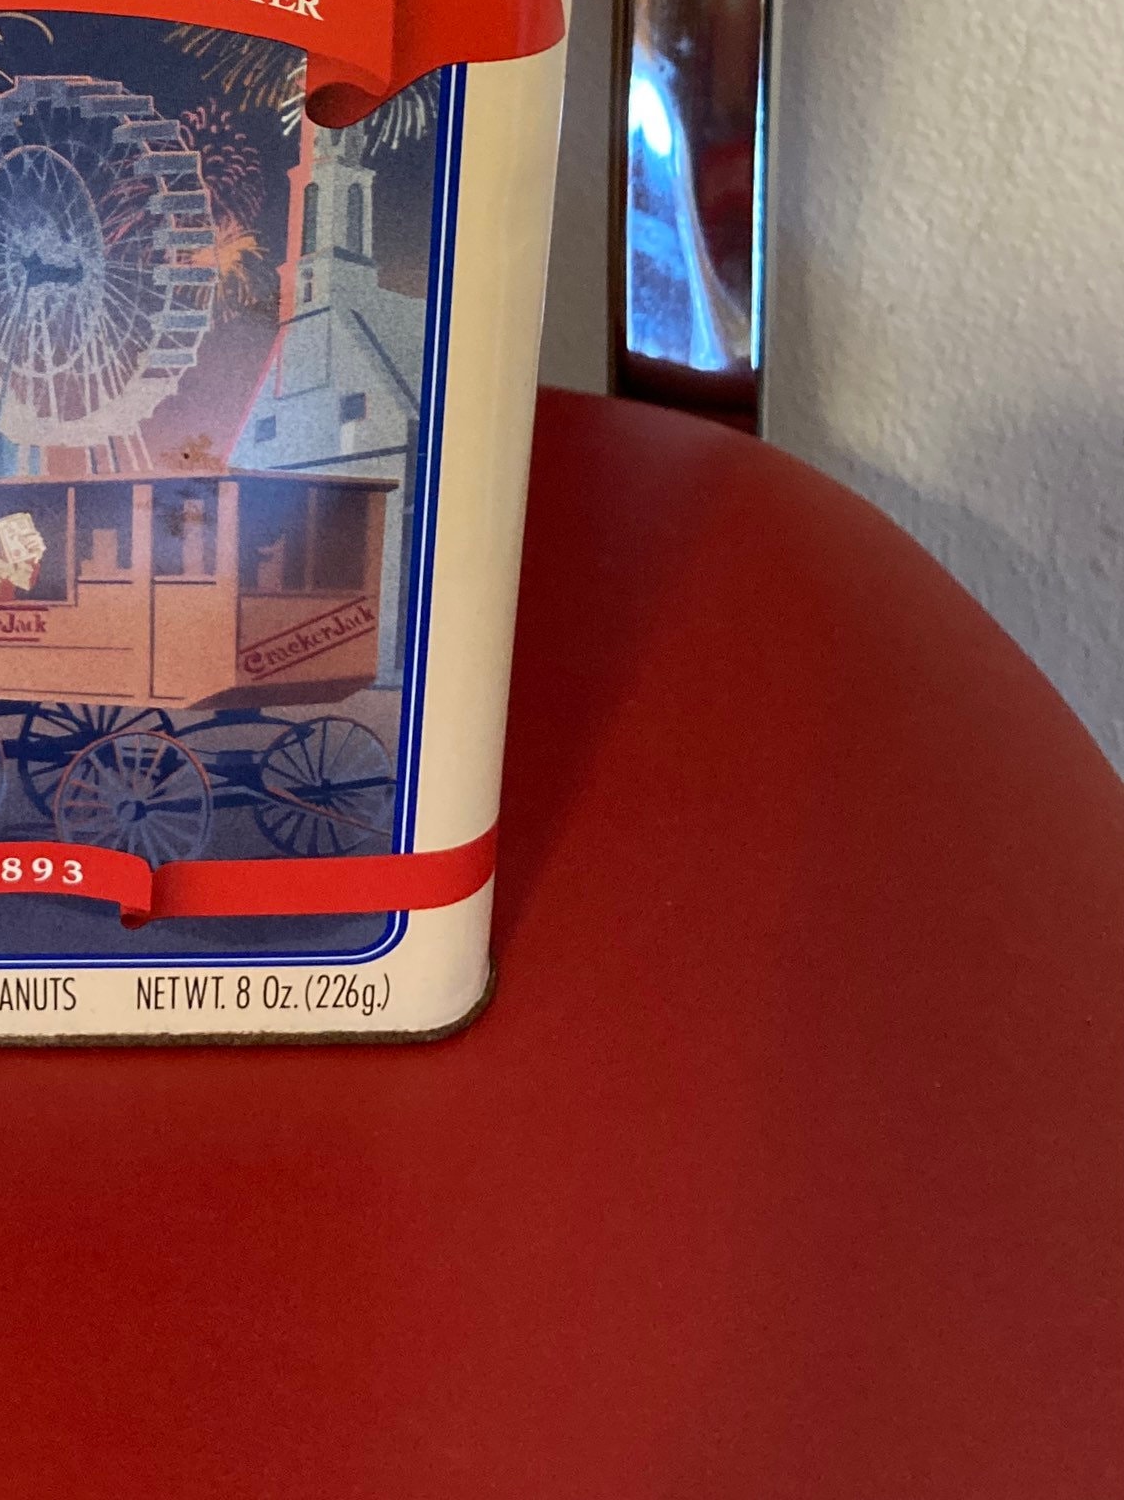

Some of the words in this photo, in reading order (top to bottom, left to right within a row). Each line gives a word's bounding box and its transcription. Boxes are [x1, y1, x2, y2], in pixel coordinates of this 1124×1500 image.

[236, 975, 251, 1010] 8
[263, 975, 298, 1010] Oz.
[305, 973, 391, 1017] (226g.)
